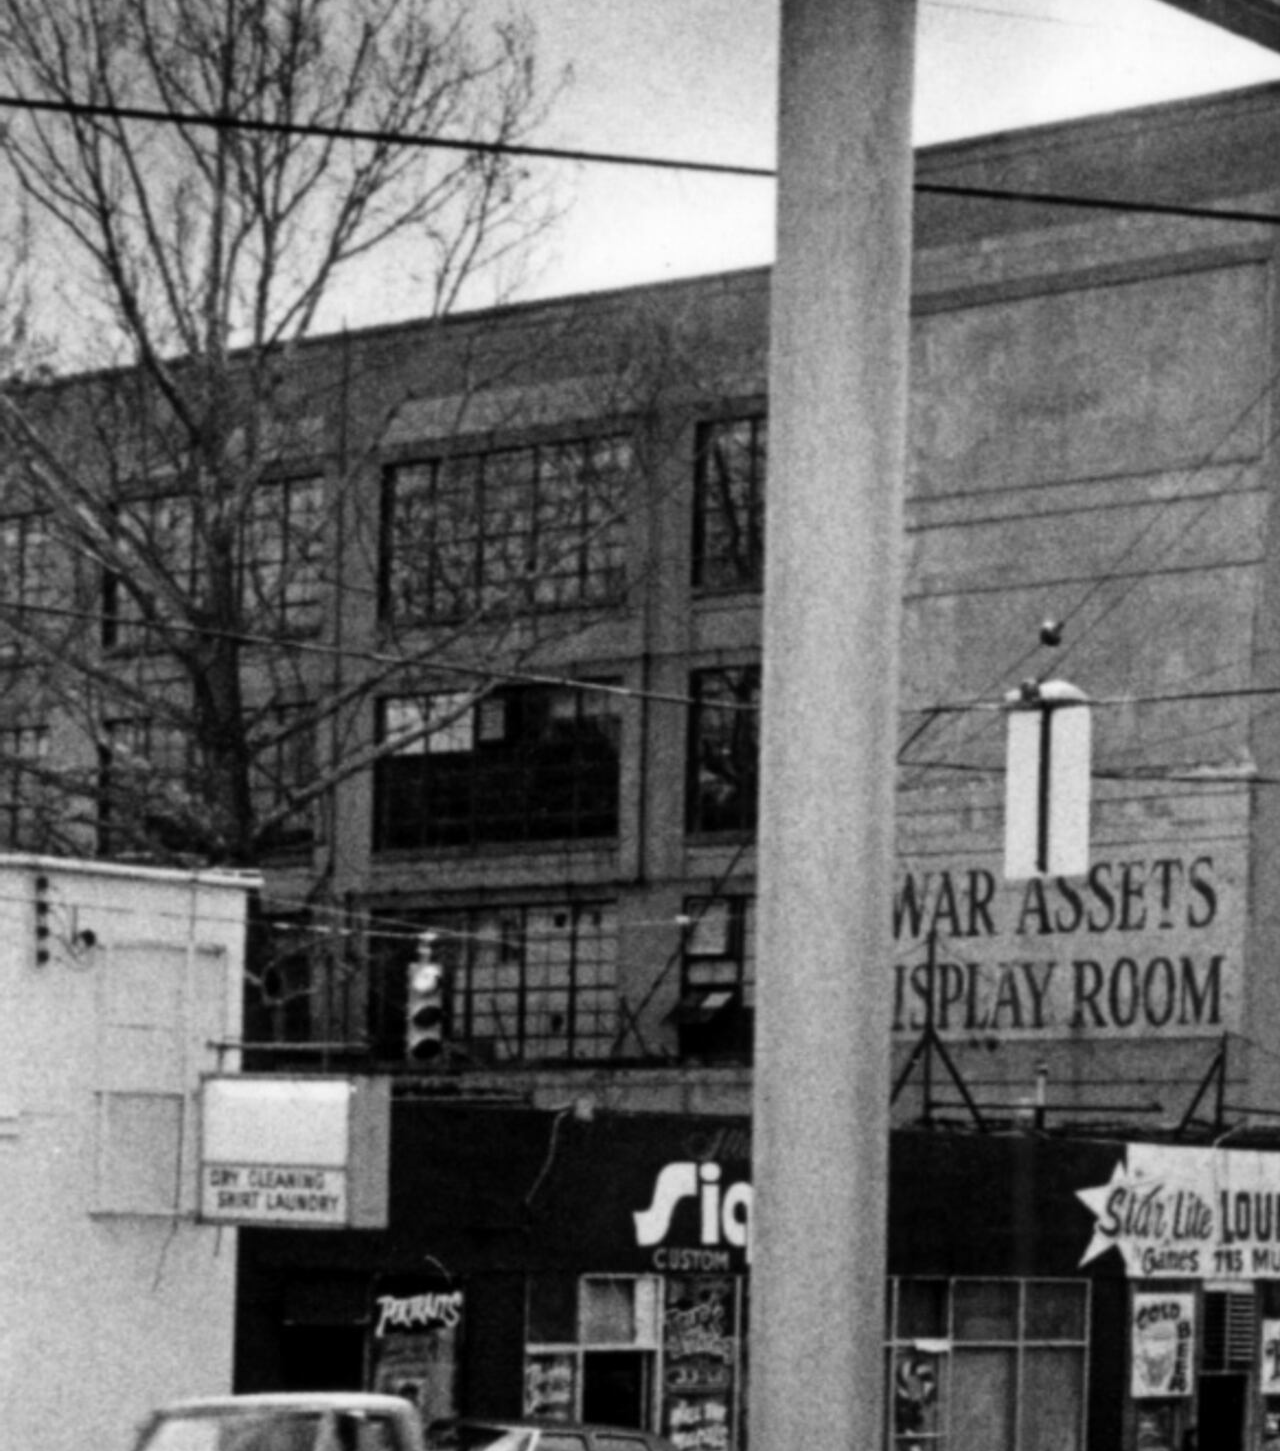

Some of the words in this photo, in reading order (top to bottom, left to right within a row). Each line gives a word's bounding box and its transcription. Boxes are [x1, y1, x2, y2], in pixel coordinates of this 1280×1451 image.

[892, 866, 1000, 940] WAR
[1012, 856, 1218, 936] ASSETS
[1068, 955, 1224, 1030] ROOM
[653, 1249, 730, 1271] CUSTOM
